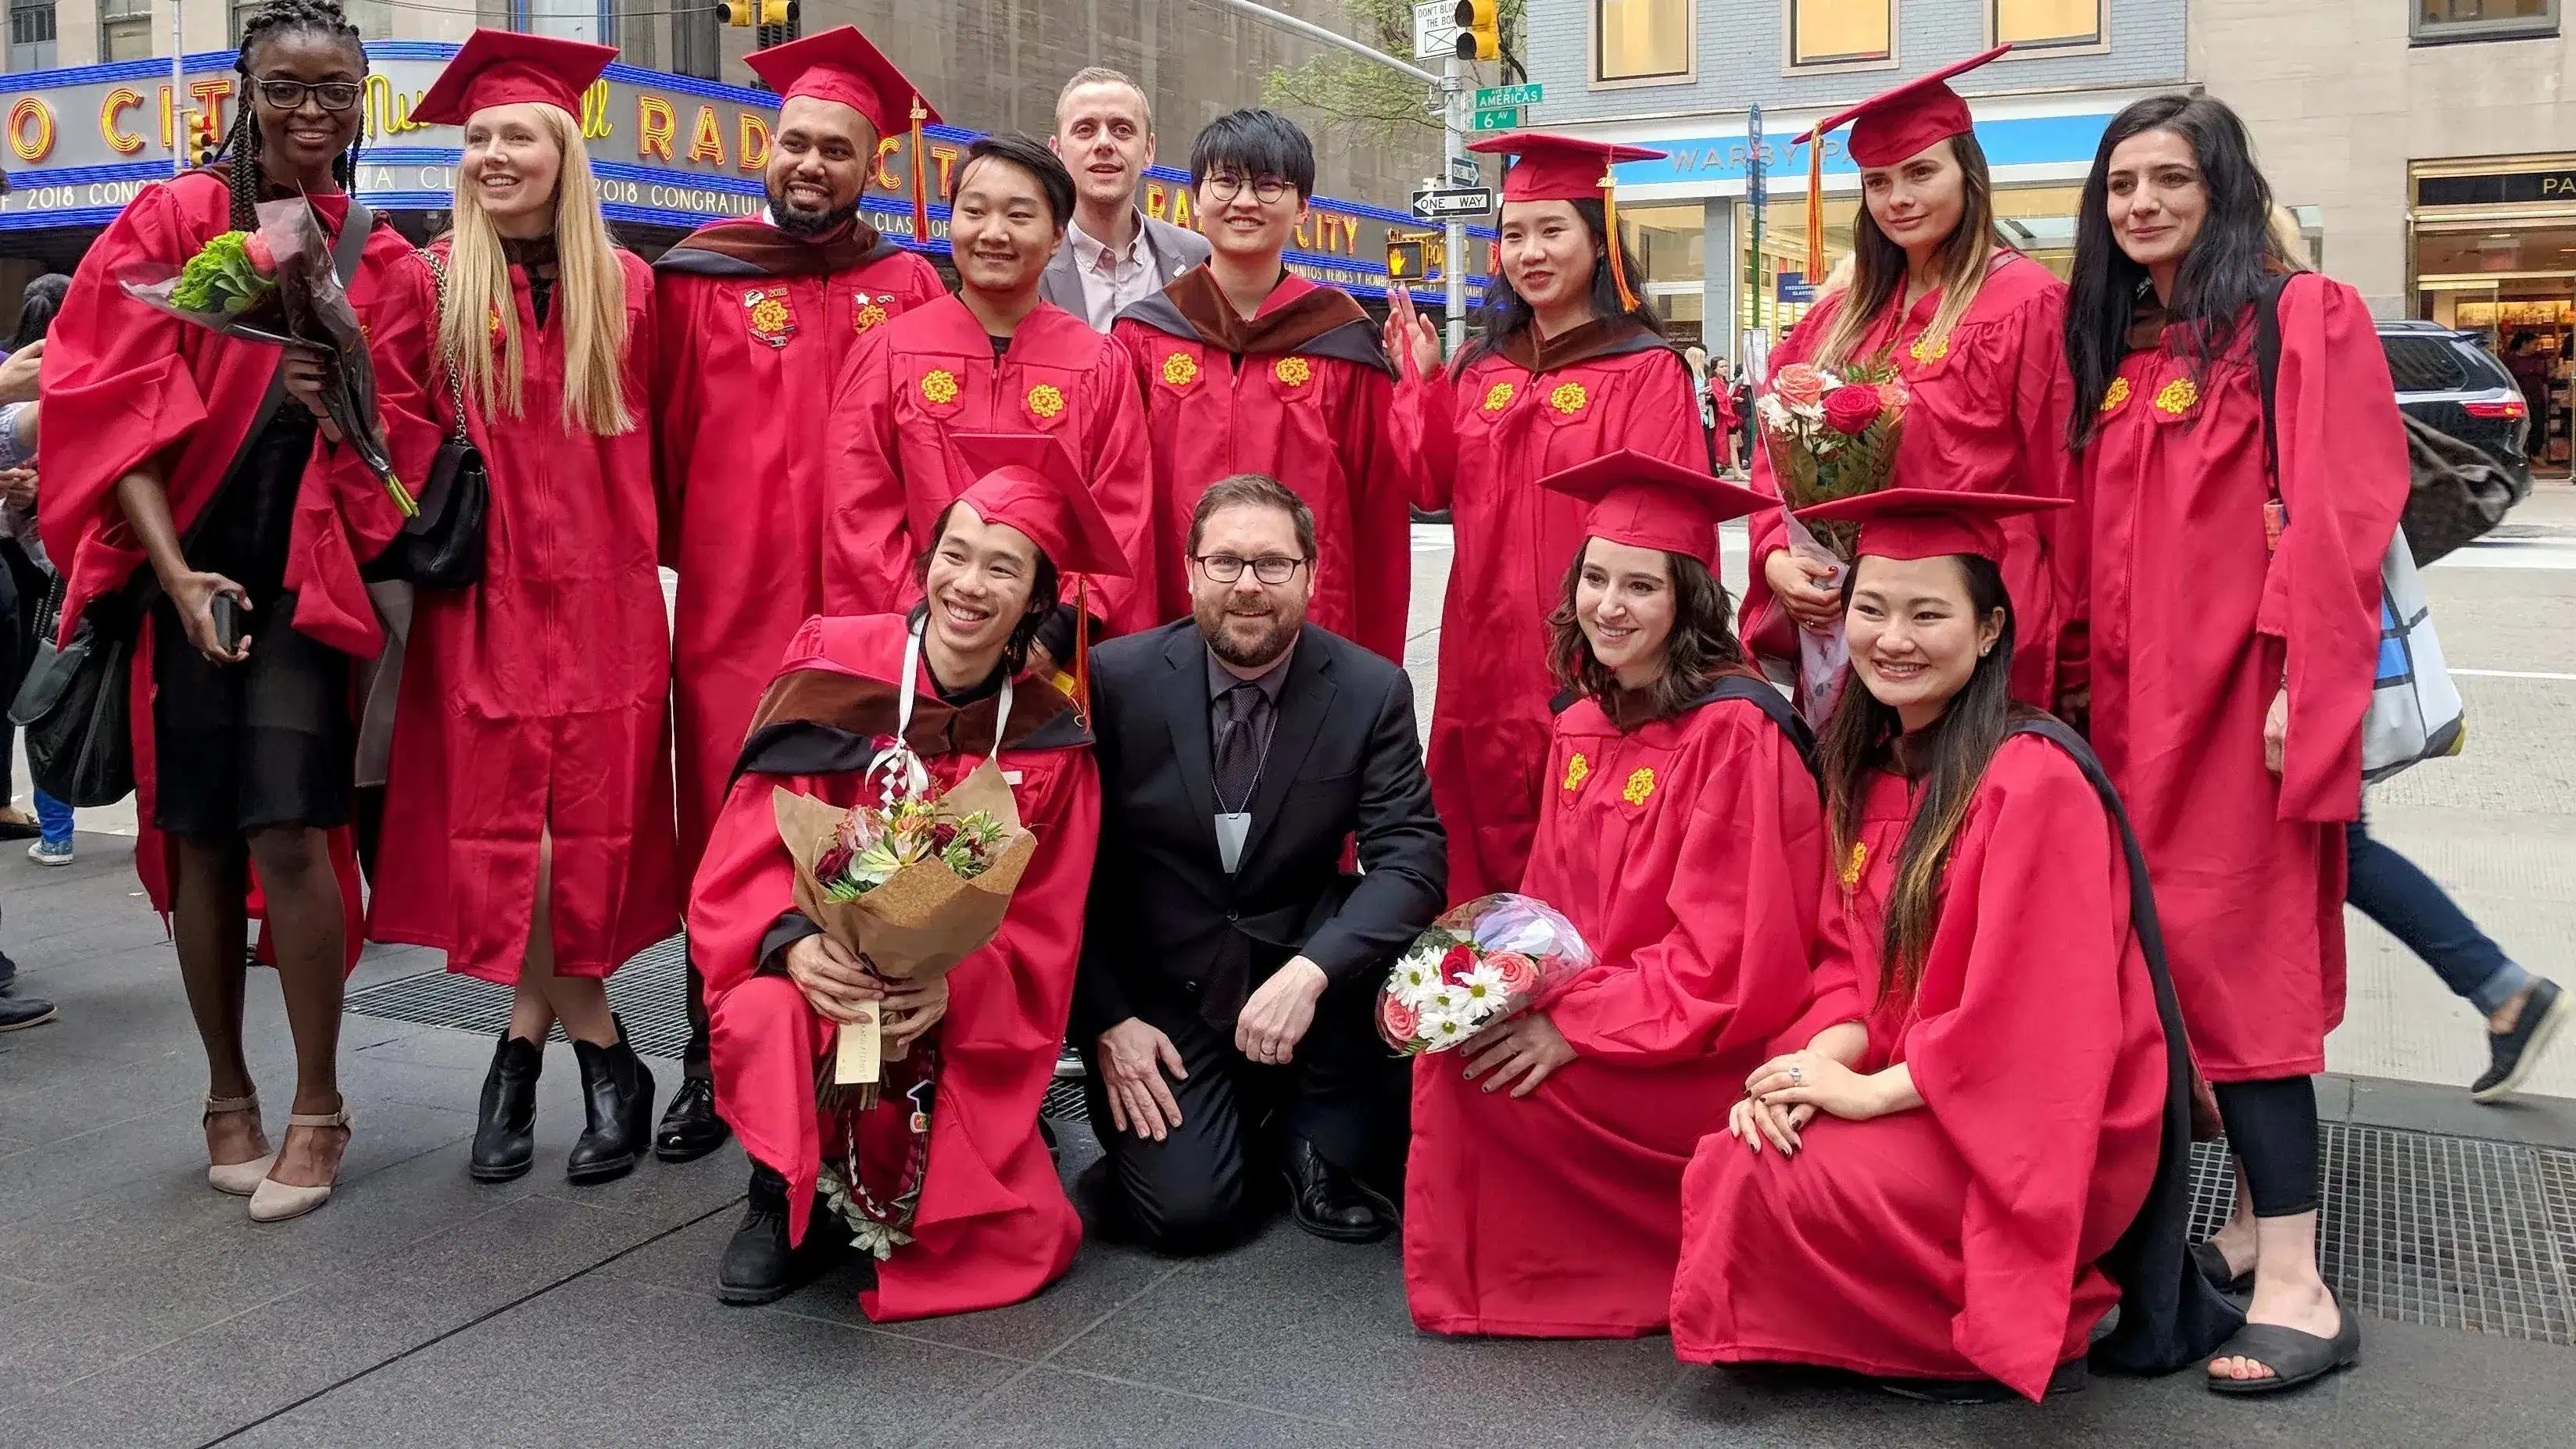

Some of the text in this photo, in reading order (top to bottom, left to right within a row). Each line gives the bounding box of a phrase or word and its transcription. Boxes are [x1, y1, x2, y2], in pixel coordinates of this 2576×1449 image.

[1418, 2, 1459, 19] DON'T BLOC
[1426, 15, 1455, 28] THE BOX
[1479, 90, 1538, 107] AMERICAS
[100, 79, 233, 154] CIT
[1483, 110, 1508, 128] 6 AV
[638, 95, 771, 170] RAD
[1669, 144, 1799, 174] WARBY
[355, 166, 393, 188] VA
[27, 185, 74, 209] 2018
[595, 179, 757, 216] 2018 CONGRATU
[1420, 196, 1483, 209] ONE WAY
[875, 212, 914, 234] CLAS
[931, 219, 950, 238] OF
[1326, 268, 1354, 284] VERDES
[1358, 273, 1363, 284] Y
[767, 287, 788, 298] 2018
